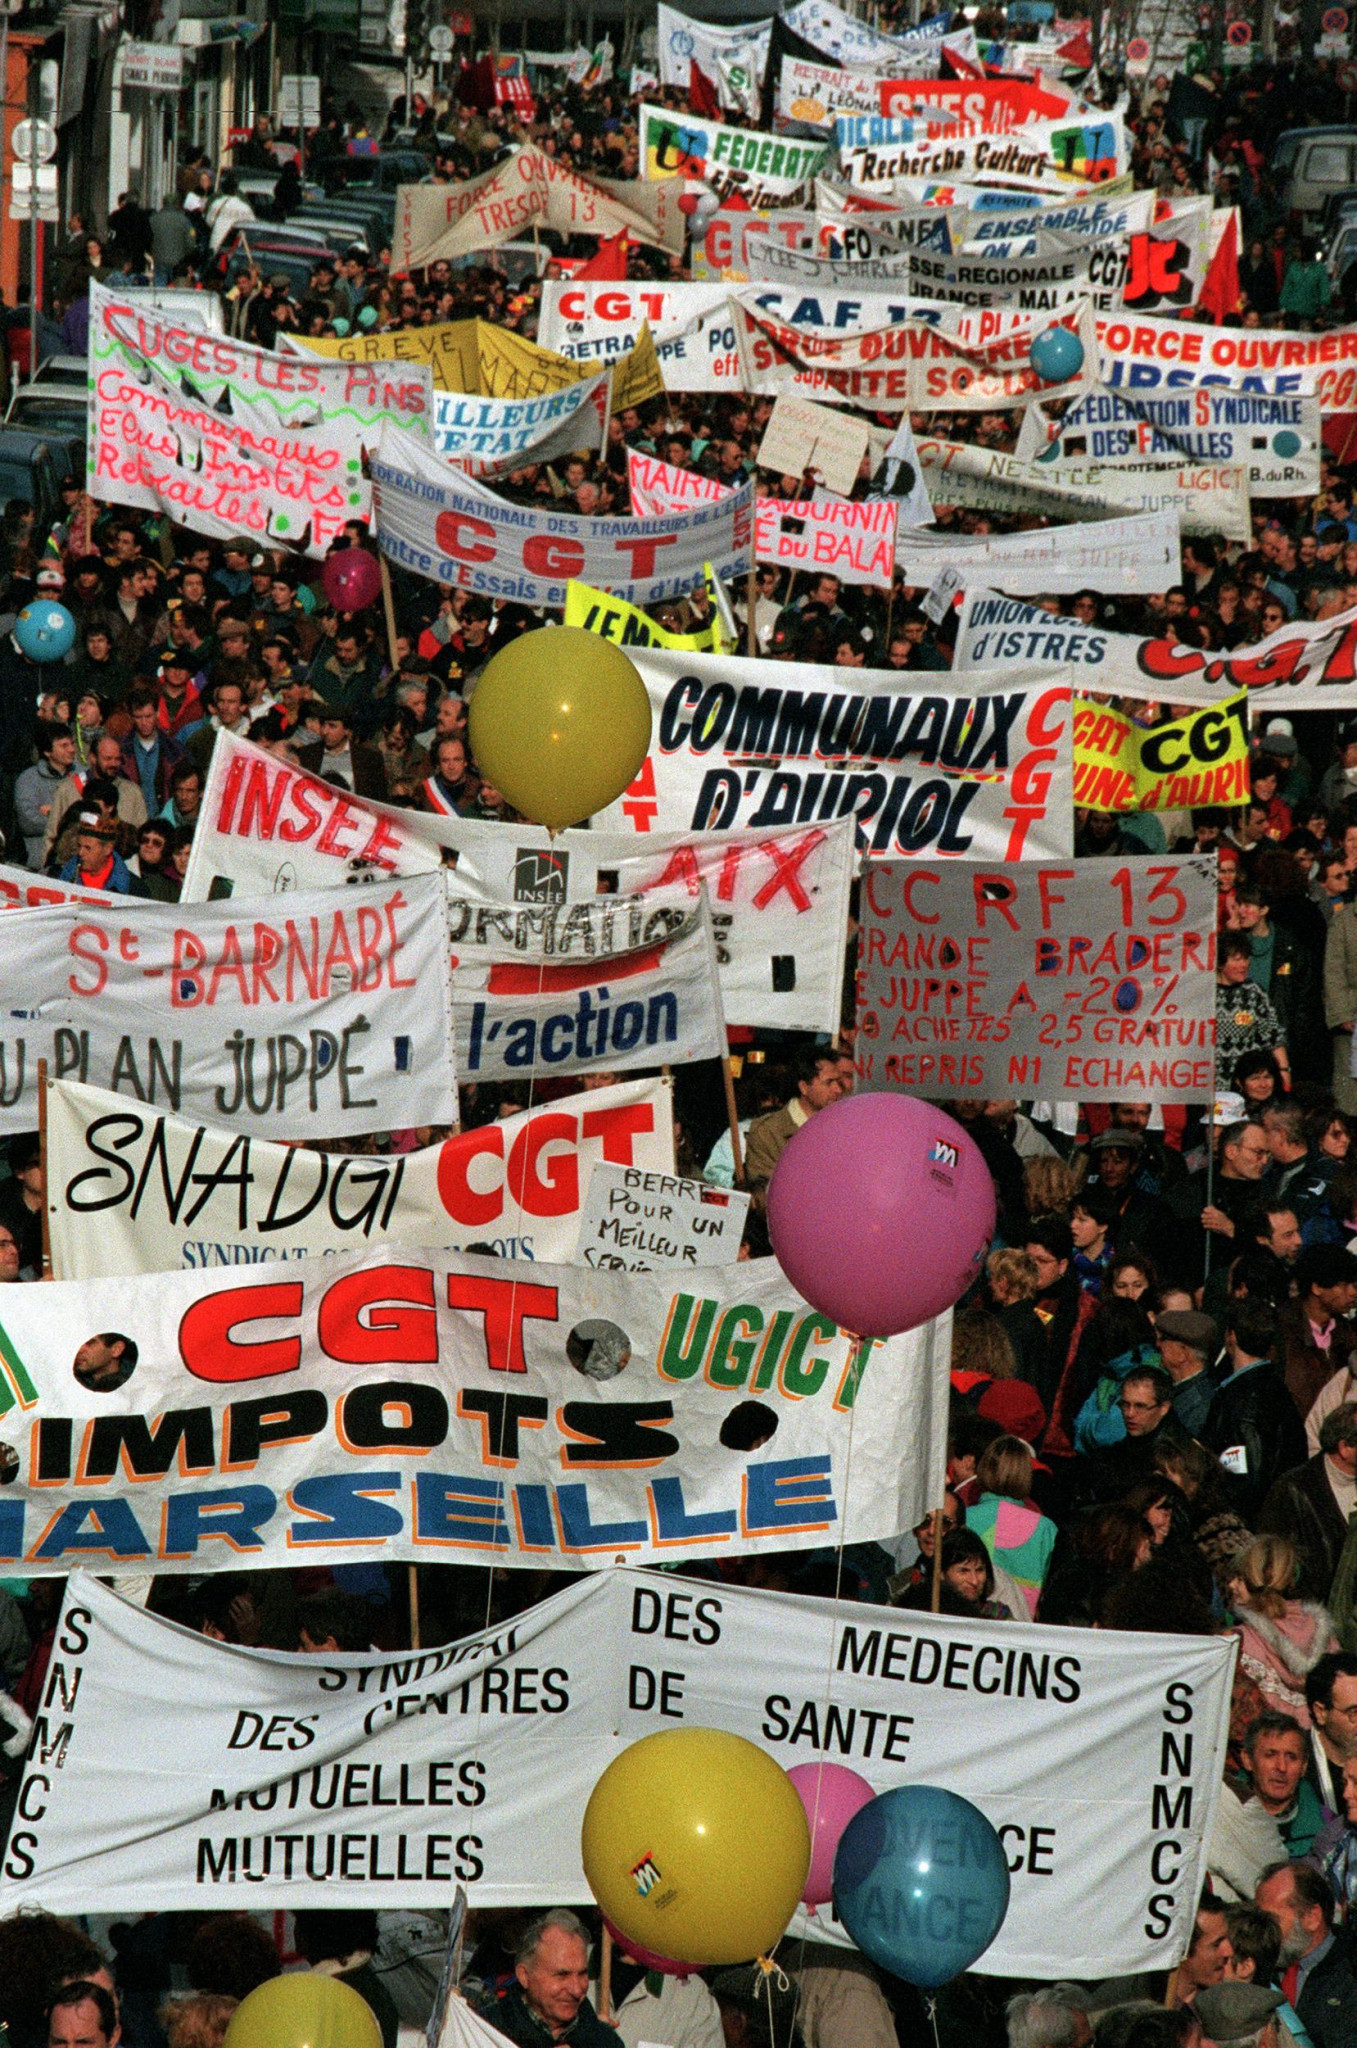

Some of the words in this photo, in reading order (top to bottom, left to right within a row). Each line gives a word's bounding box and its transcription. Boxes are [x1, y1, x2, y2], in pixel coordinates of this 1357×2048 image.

[861, 147, 966, 183] Recherche
[844, 226, 872, 259] FO
[974, 202, 1108, 241] ENSEMBLE
[957, 263, 1076, 285] REGIONALE
[1195, 388, 1302, 426] SYNDICALE
[1092, 429, 1130, 457] DES
[1136, 422, 1233, 459] FAMILLES
[452, 493, 537, 530] NATIONALE
[547, 516, 579, 535] DES
[591, 512, 690, 537] TRAVAILLEURS
[434, 509, 679, 580] CGT
[777, 537, 810, 558] DU
[968, 600, 1039, 629] UNION
[972, 630, 1108, 665] d'ISTRES
[659, 676, 1027, 772] COMMUNAUX
[217, 754, 403, 871] INSEE
[516, 887, 564, 903] INSEE
[1110, 866, 1188, 927] 13
[880, 976, 988, 1018] JUPPE
[1006, 981, 1037, 1014] A
[1064, 974, 1181, 1016] -20%
[467, 986, 678, 1070] l'action
[890, 1014, 1013, 1044] ACHETES
[1037, 1013, 1084, 1049] 2,5
[885, 1052, 985, 1086] REPRIS
[1062, 1055, 1212, 1090] ECHANGE
[66, 1111, 408, 1238] SNADGI
[436, 1102, 655, 1226] CGT
[691, 1216, 724, 1238] UN
[178, 1263, 560, 1384] CGT
[656, 1291, 890, 1414] UGICT
[29, 1381, 681, 1488] IMPOTS
[630, 1586, 724, 1646] DES
[835, 1625, 1083, 1704] MEDECINS
[227, 1709, 320, 1751] DES
[363, 1666, 571, 1736] CENTRES
[627, 1664, 685, 1720] DE
[761, 1692, 916, 1763] SANTE
[195, 1833, 485, 1884] MUTUELLES
